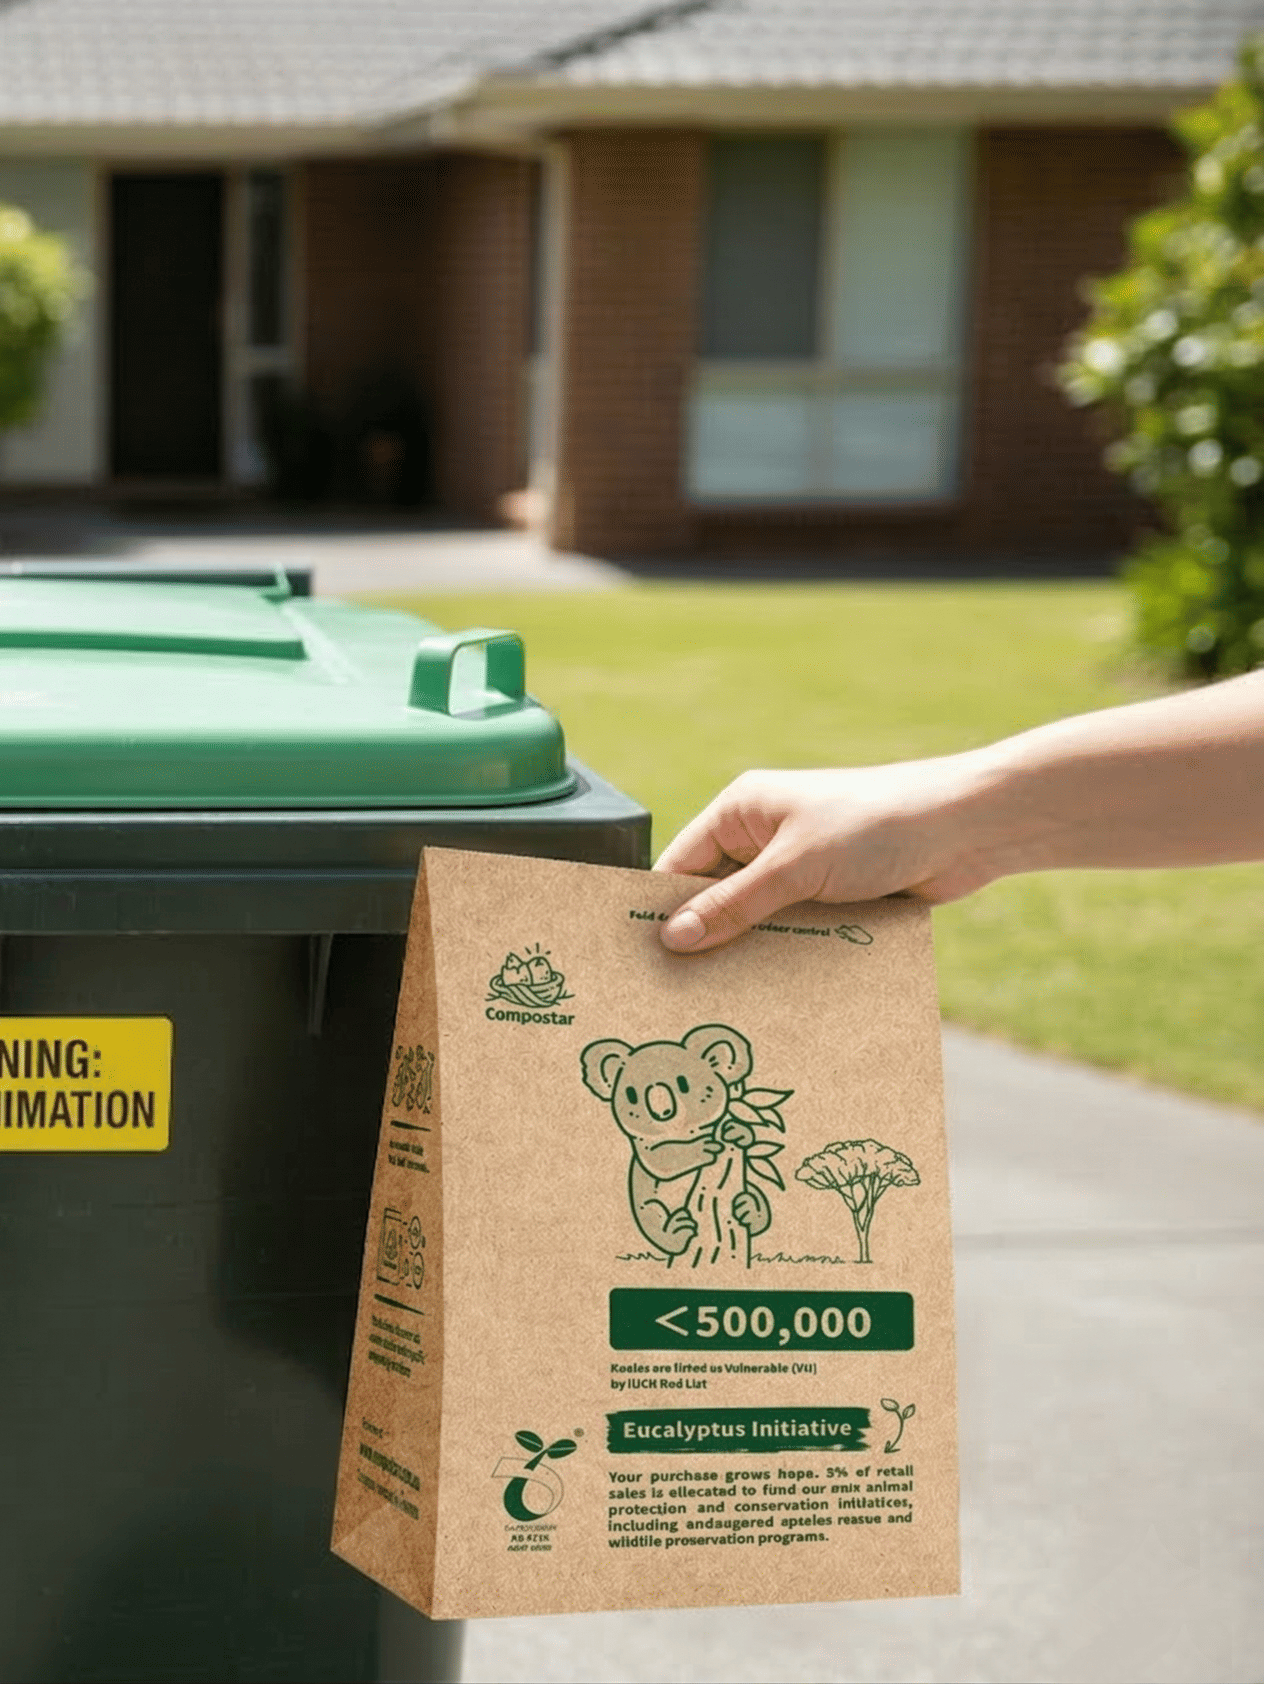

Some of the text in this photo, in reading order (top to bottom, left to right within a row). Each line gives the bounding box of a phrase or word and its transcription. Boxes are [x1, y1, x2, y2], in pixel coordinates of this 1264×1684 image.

[485, 1006, 576, 1026] Compostar
[610, 1378, 627, 1392] by
[622, 1418, 853, 1442] Eucalyptus Initiative
[608, 1471, 643, 1483] Your
[724, 1470, 772, 1484] grows
[608, 1487, 647, 1500] sales
[741, 1485, 757, 1497] to
[801, 1485, 827, 1495] our
[697, 1501, 725, 1514] and
[734, 1498, 829, 1513] conservation
[608, 1517, 679, 1534] including
[887, 1511, 914, 1524] and
[757, 1532, 830, 1547] programs.
